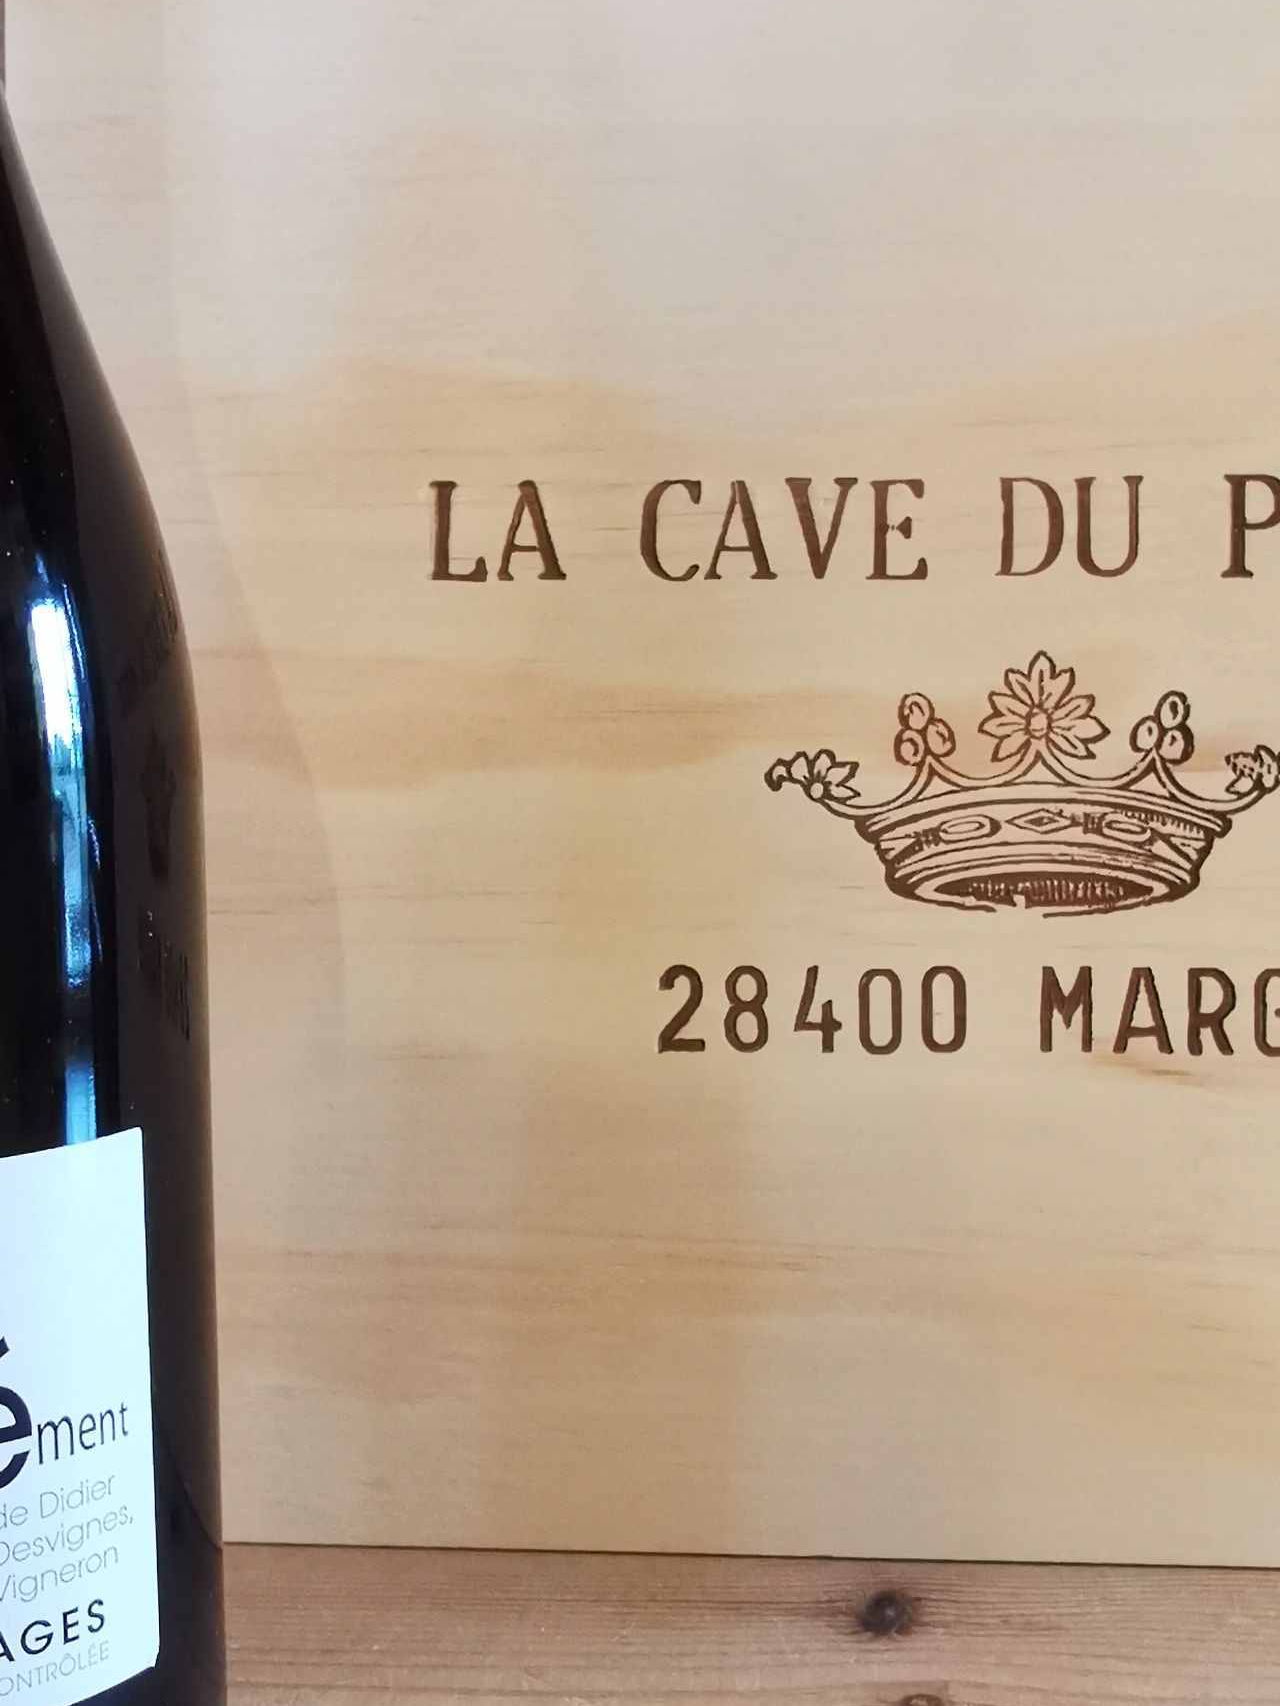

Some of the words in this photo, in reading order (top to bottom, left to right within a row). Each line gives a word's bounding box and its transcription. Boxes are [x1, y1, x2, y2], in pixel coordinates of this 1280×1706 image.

[428, 477, 566, 584] LA
[640, 475, 930, 584] CAVE
[995, 473, 1144, 581] DU
[657, 963, 968, 1056] 28400
[39, 1474, 116, 1520] Didier
